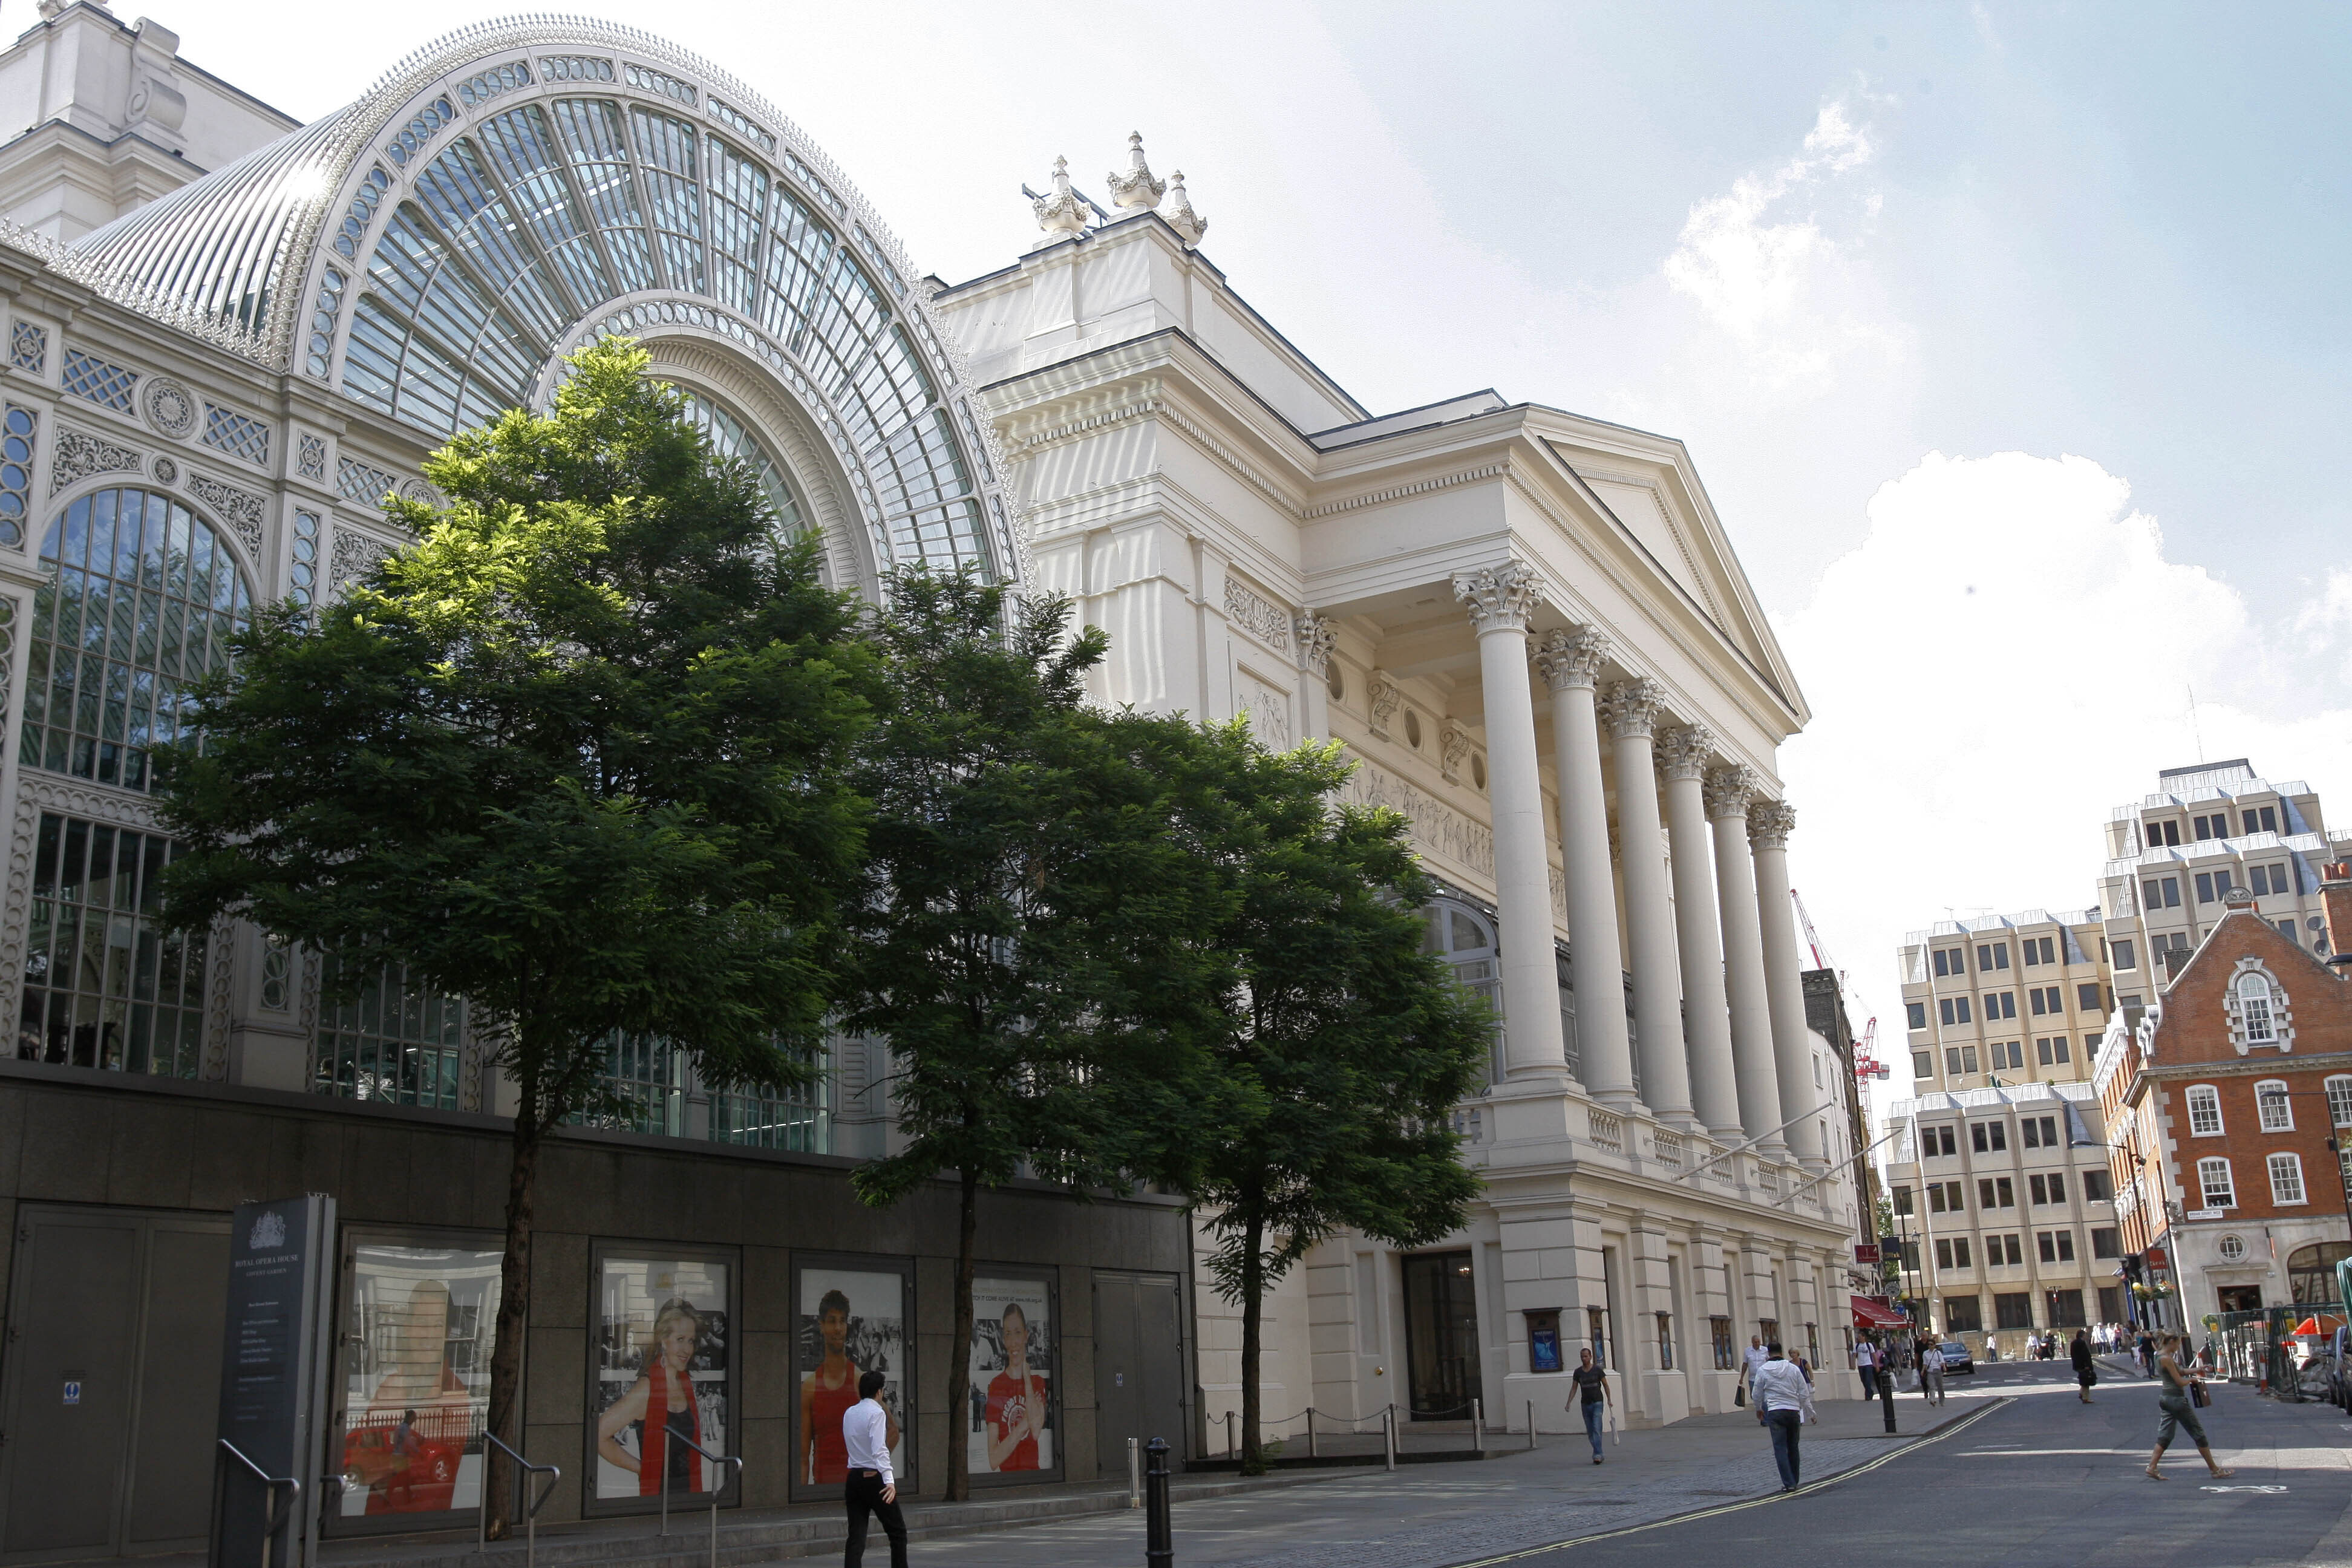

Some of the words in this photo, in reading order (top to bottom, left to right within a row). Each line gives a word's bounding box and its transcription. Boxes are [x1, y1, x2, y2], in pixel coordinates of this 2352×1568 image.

[235, 1259, 254, 1268] ROYAL
[255, 1256, 276, 1265] OPERA
[277, 1254, 299, 1263] HOUSE
